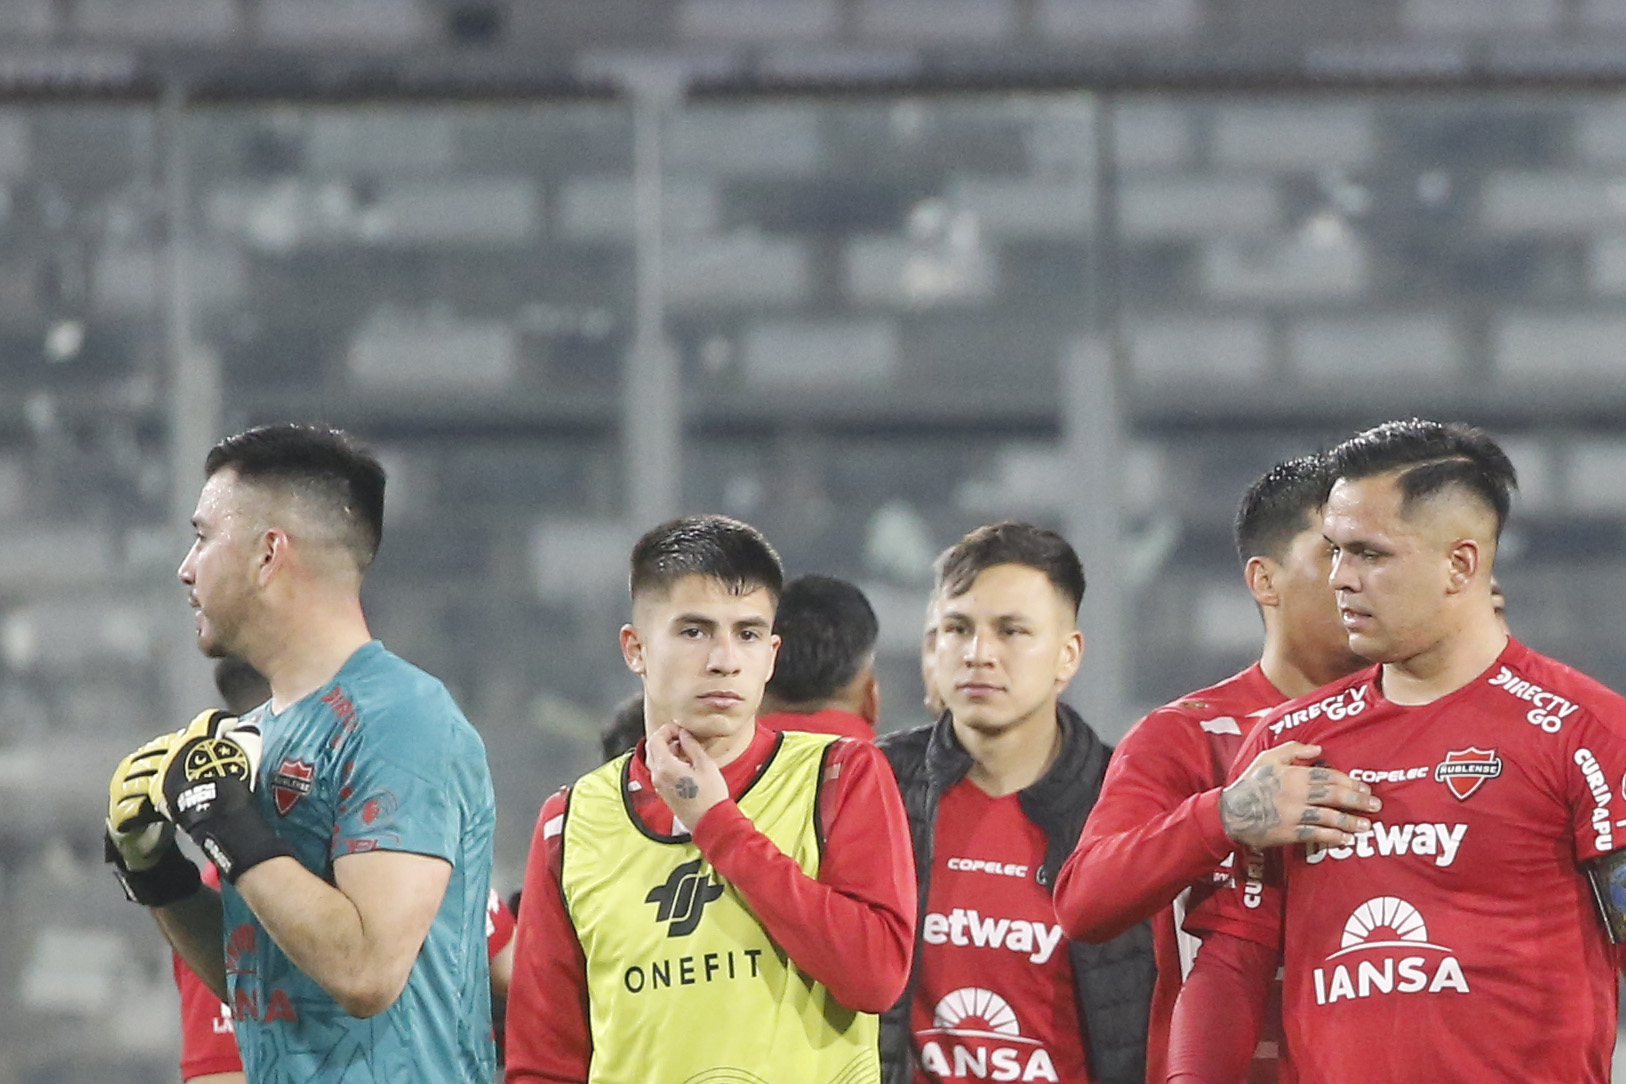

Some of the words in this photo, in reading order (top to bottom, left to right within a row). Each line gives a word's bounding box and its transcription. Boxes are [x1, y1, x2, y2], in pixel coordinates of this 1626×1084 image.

[1326, 700, 1366, 721] GO
[1488, 665, 1578, 718] DIRECTV
[1526, 708, 1563, 733] GO
[1349, 767, 1429, 783] COPELEC
[947, 857, 1029, 878] COPELEC
[923, 908, 1063, 964] etway
[624, 949, 762, 994] ONEFIT
[1313, 957, 1470, 1005] IANSA
[921, 1041, 1059, 1083] ANSA
